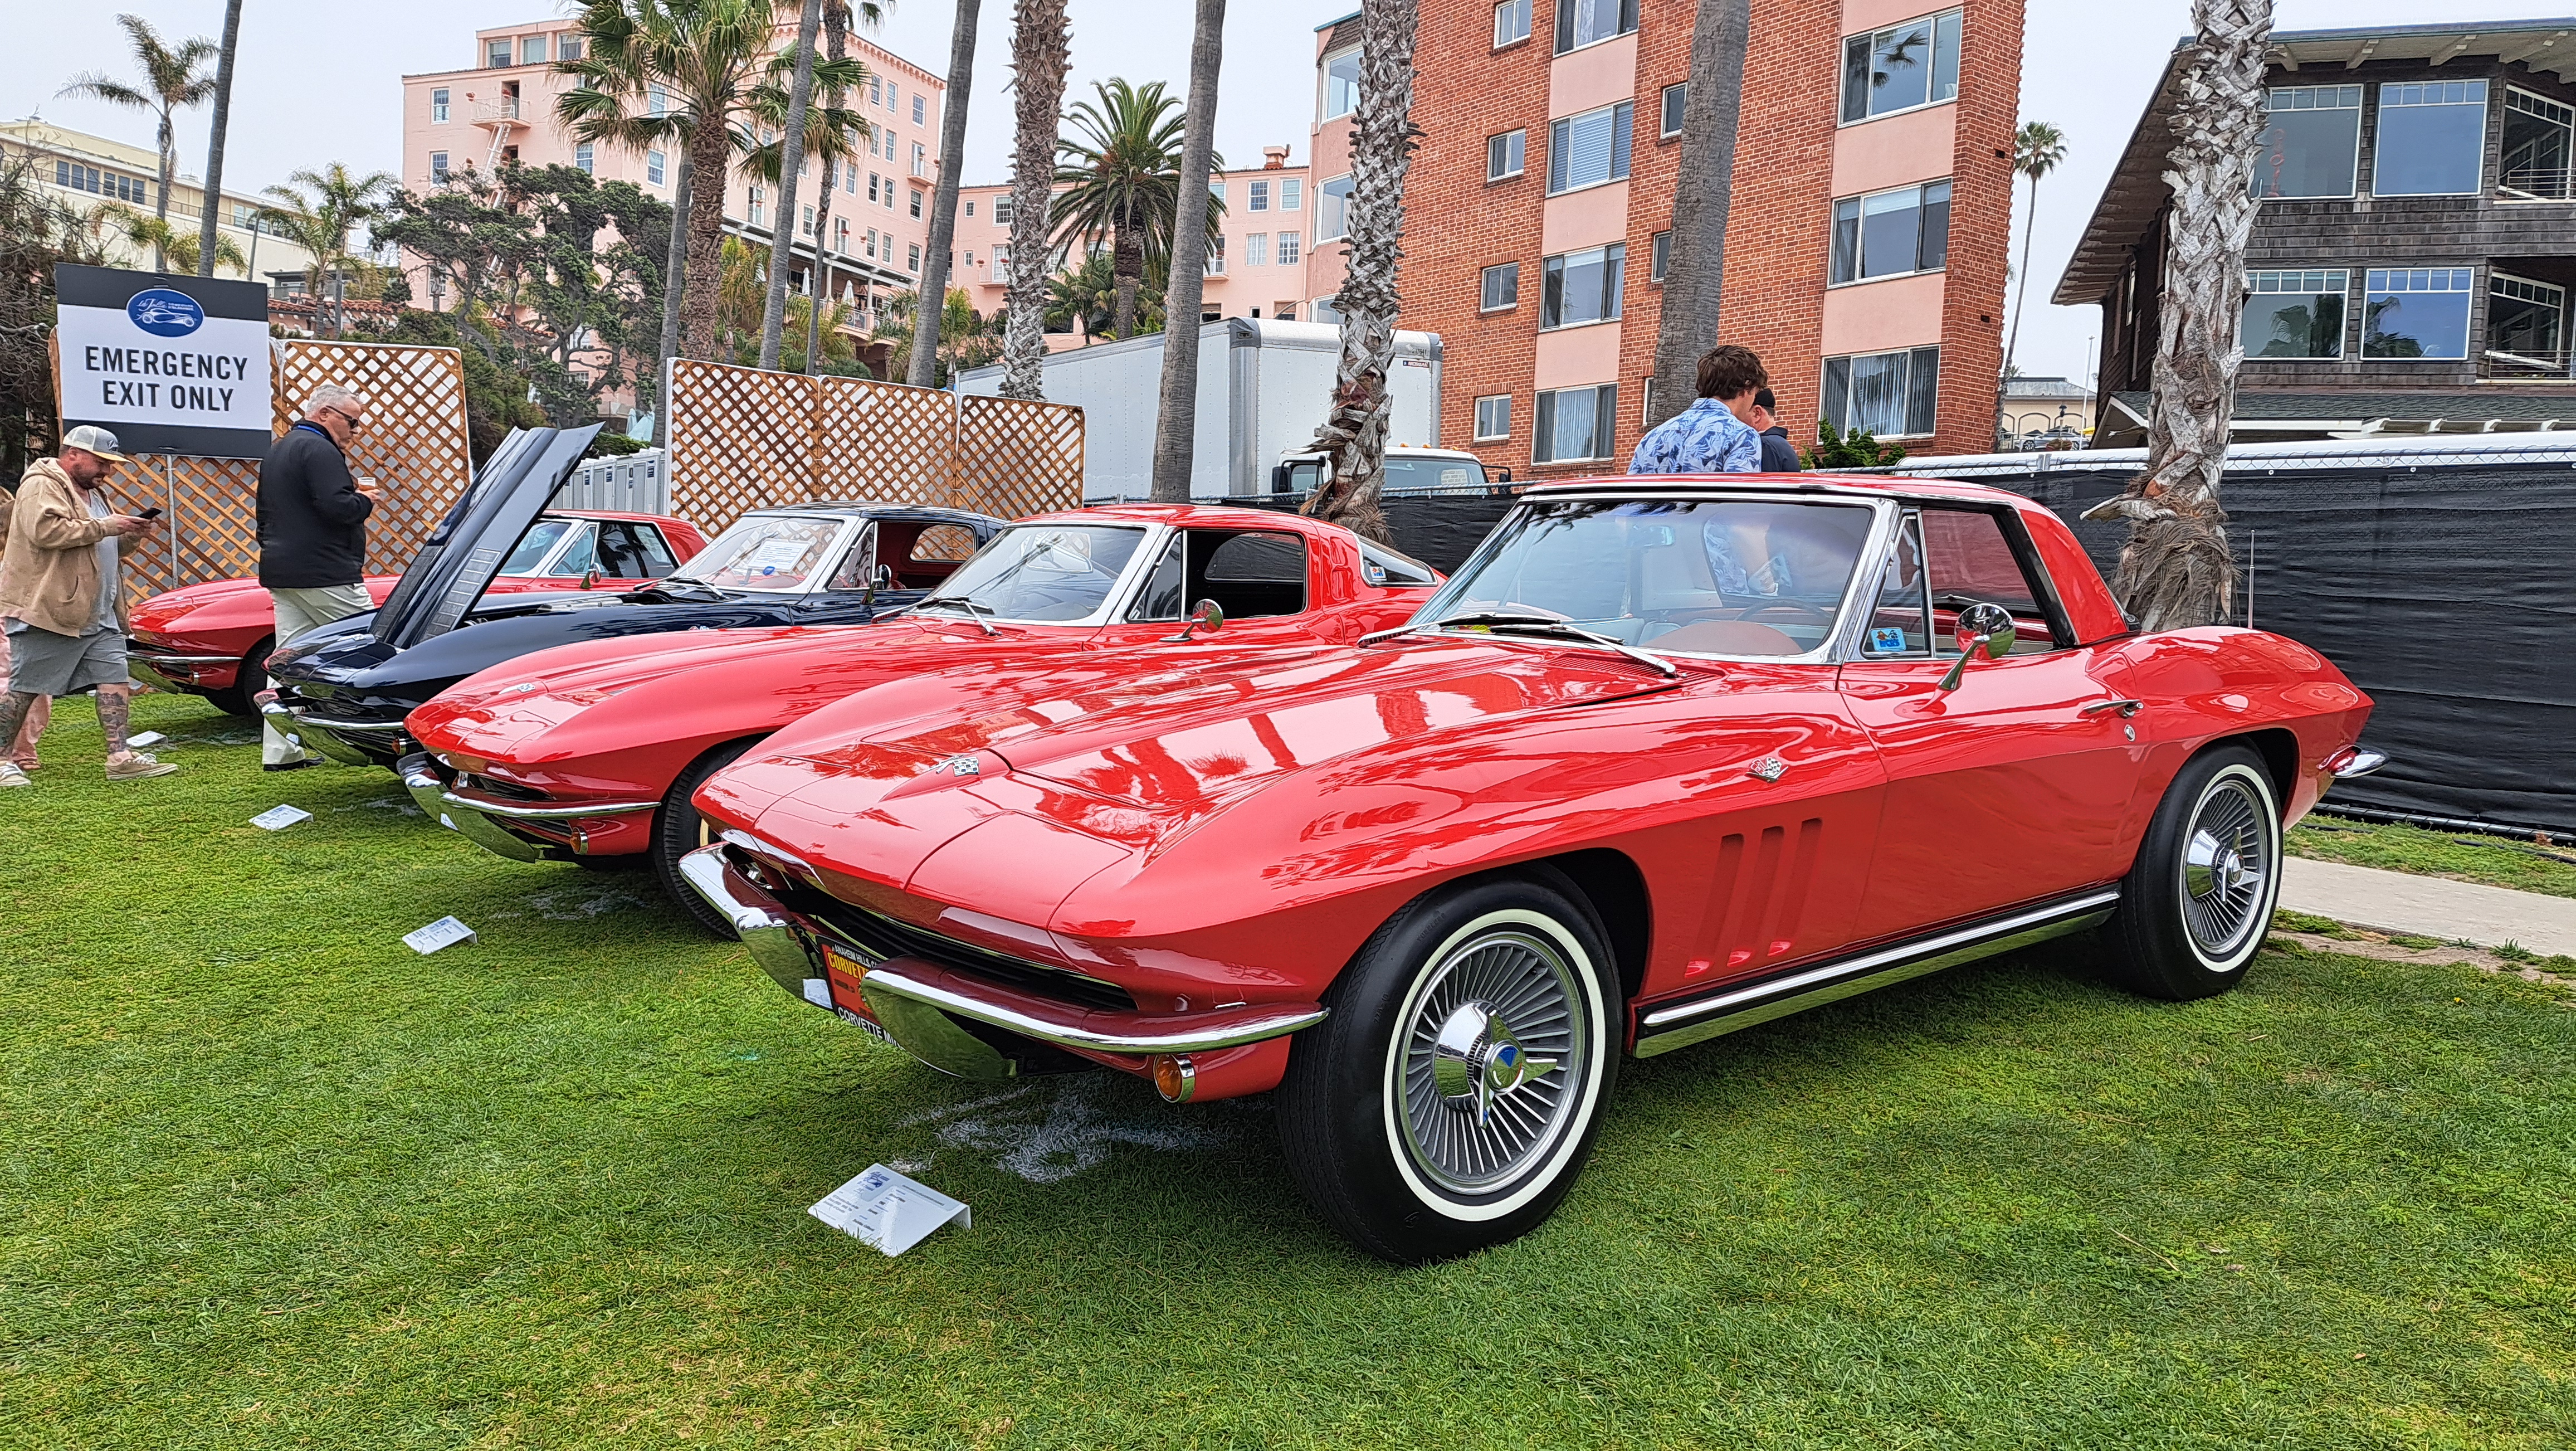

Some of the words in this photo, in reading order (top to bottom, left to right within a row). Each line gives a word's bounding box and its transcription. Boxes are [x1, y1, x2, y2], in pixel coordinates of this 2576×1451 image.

[85, 345, 248, 381] EMERGENCY
[103, 380, 160, 407] EXIT
[170, 384, 234, 412] ONLY
[827, 952, 870, 980] CORVETT
[838, 1006, 883, 1039] CORVETTE
